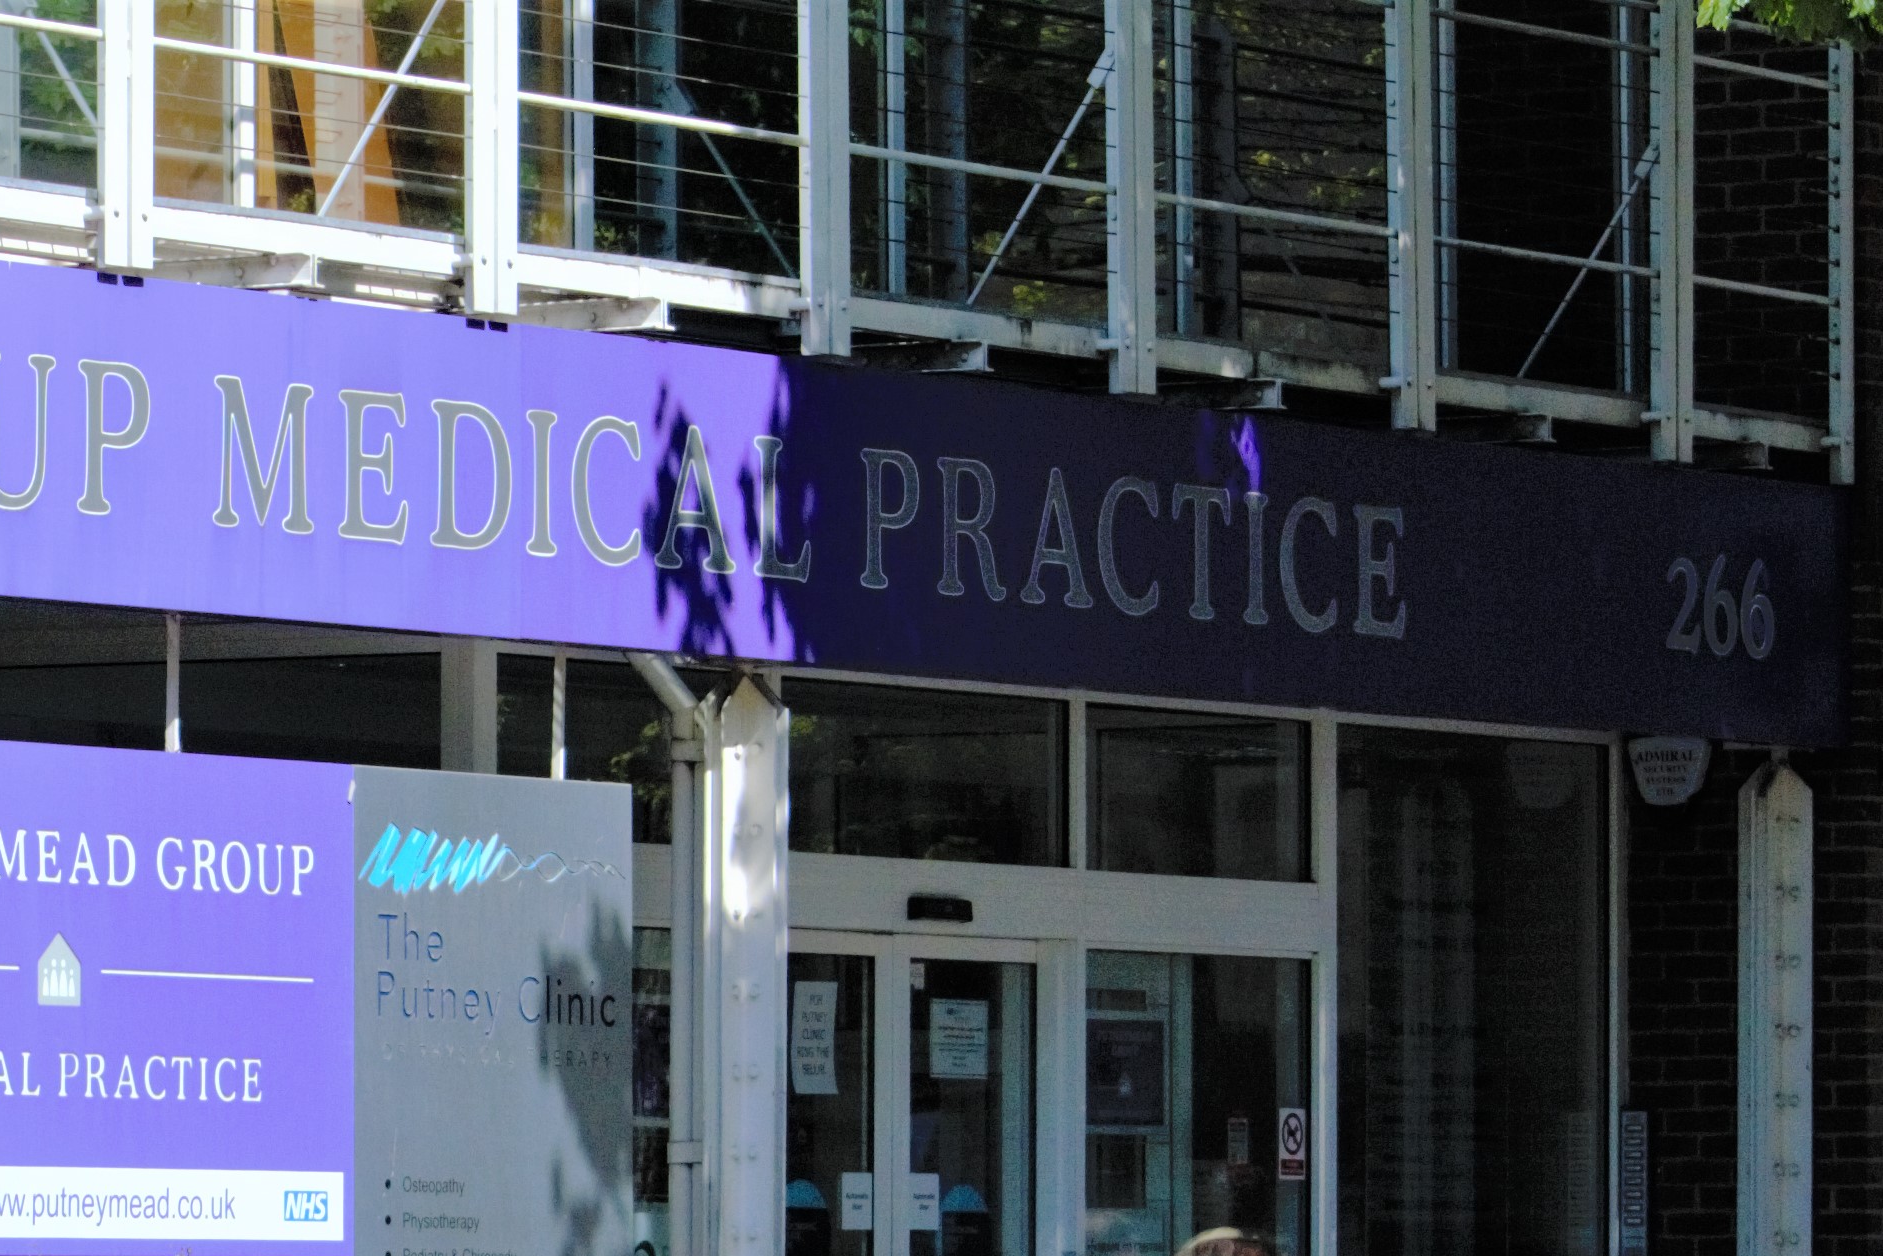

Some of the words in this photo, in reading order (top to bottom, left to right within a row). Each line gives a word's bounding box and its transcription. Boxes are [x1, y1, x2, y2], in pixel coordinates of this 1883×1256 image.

[212, 374, 811, 583] MEDICAL
[860, 447, 1406, 640] PRACTICE
[1665, 554, 1775, 659] 266
[156, 837, 315, 897] GROUP
[377, 912, 444, 962] The
[377, 970, 501, 1038] Putney
[518, 975, 616, 1028] Clinic
[58, 1053, 263, 1103] PRACTICE
[285, 1192, 327, 1221] NHS
[402, 1176, 465, 1196] Osteopathy
[402, 1212, 480, 1233] Physiotherapy
